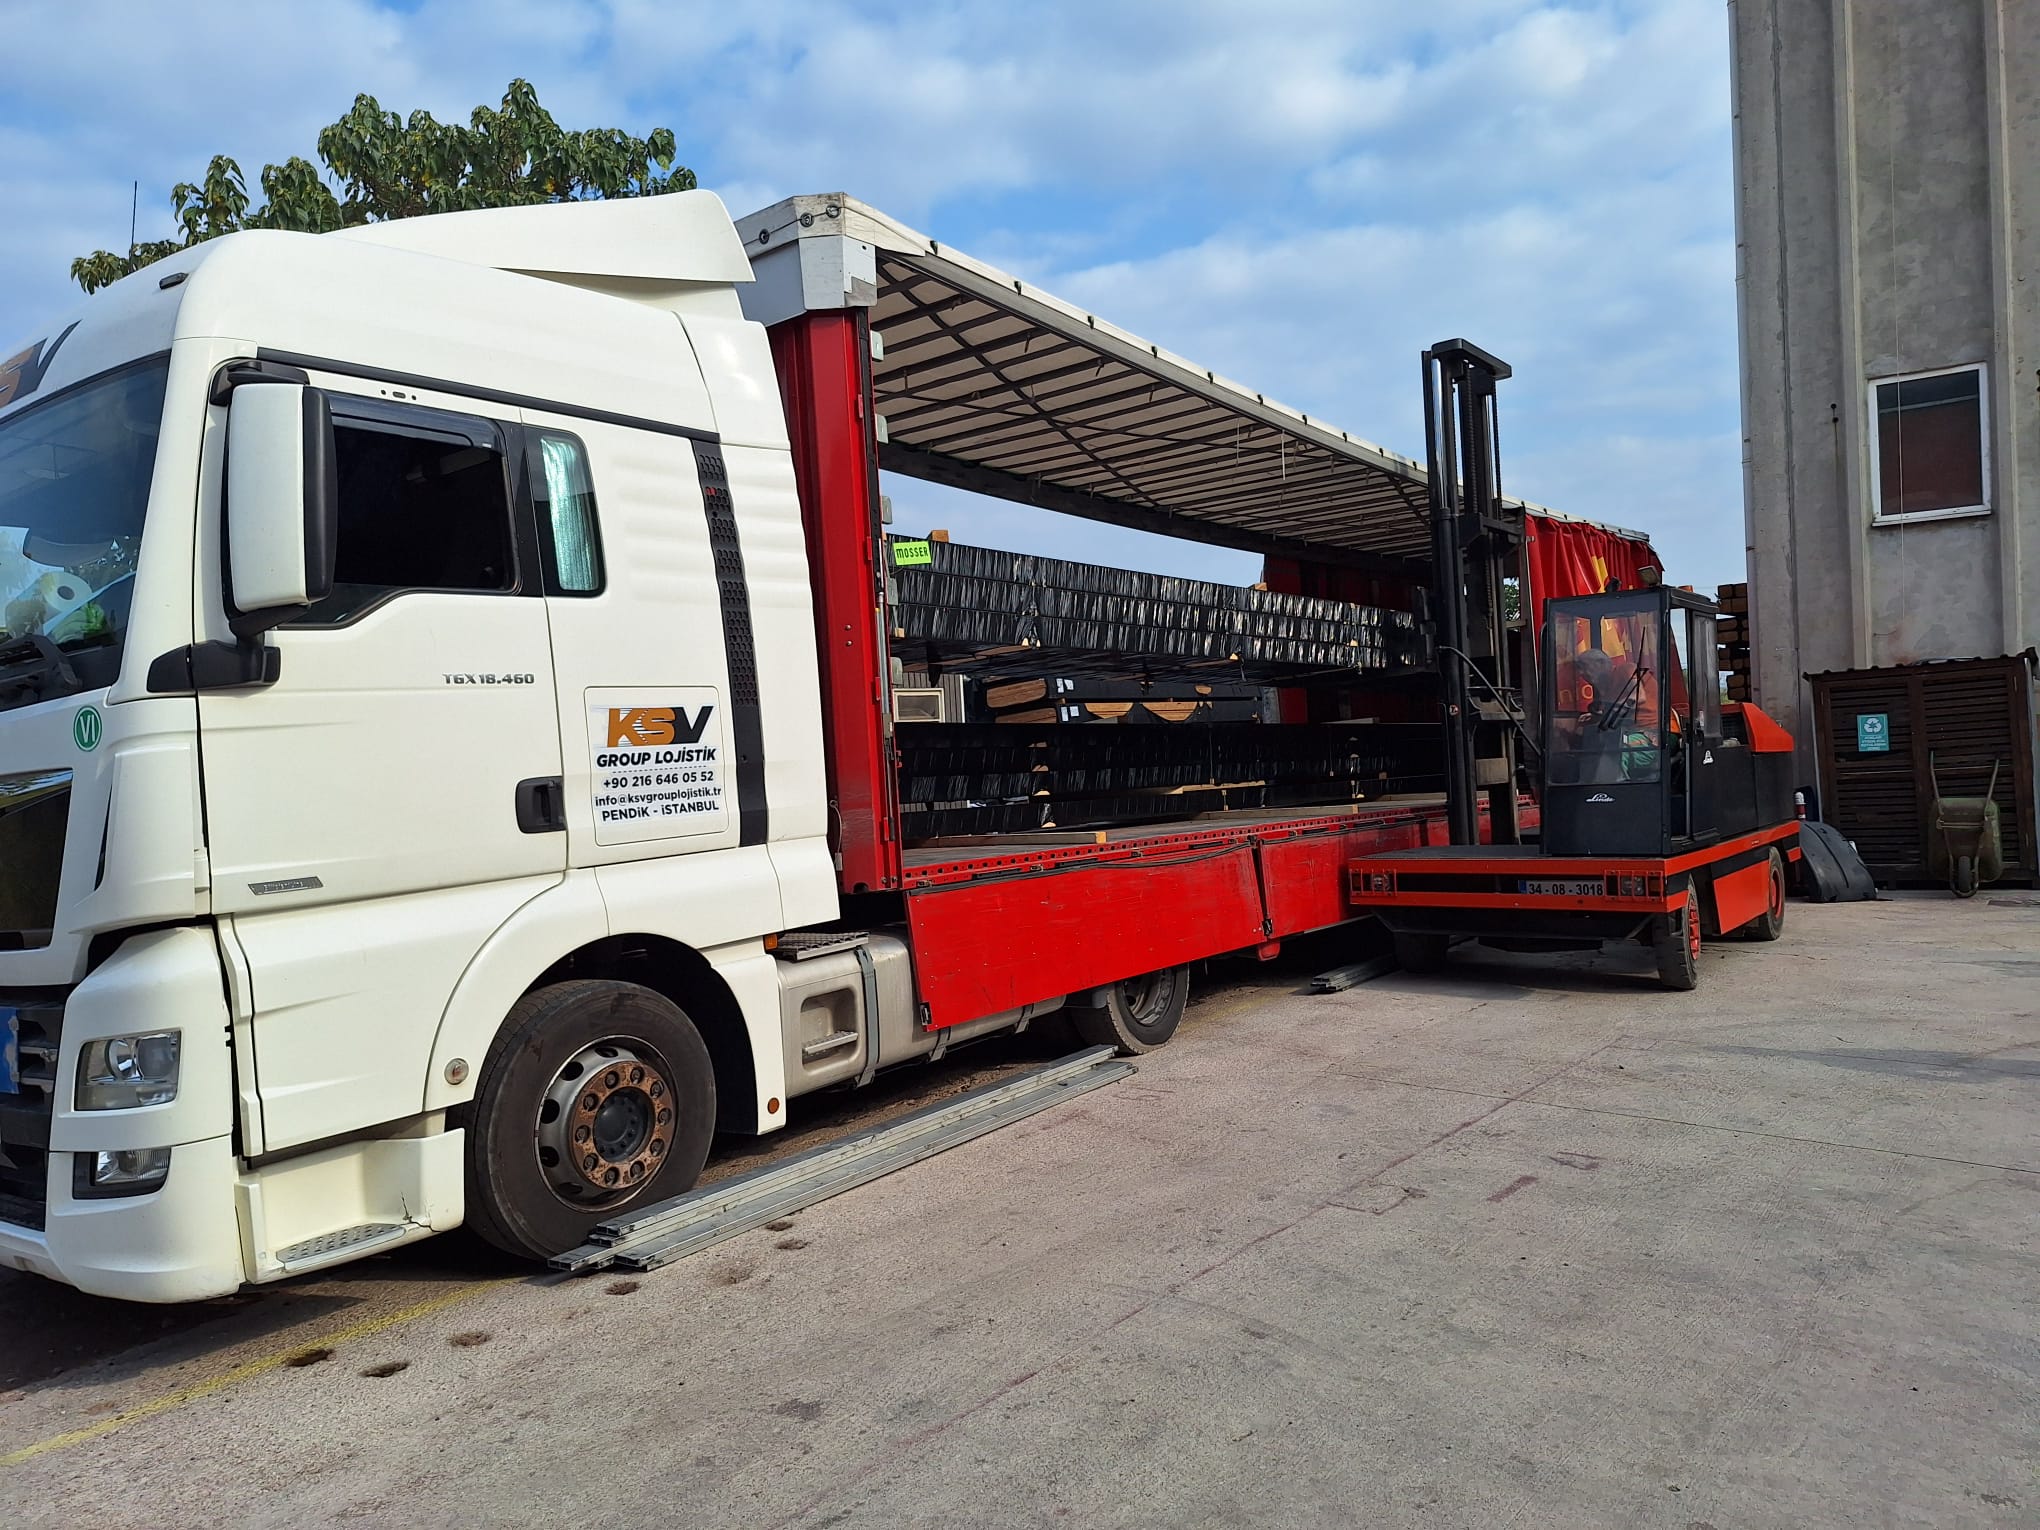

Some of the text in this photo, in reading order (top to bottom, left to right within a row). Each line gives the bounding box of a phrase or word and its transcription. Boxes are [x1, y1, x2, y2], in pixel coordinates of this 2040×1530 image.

[895, 546, 929, 559] MOSSER
[442, 673, 535, 684] TGX 18.460
[607, 705, 714, 748] KSV
[596, 746, 717, 767] GROUP LOJİSTİK
[603, 771, 714, 789] +90 216 646 05 52
[595, 787, 722, 807] info@ksvgrouplojistik.tr
[1528, 883, 1542, 895] 34
[1552, 883, 1566, 895] 08
[1576, 883, 1604, 896] 3018
